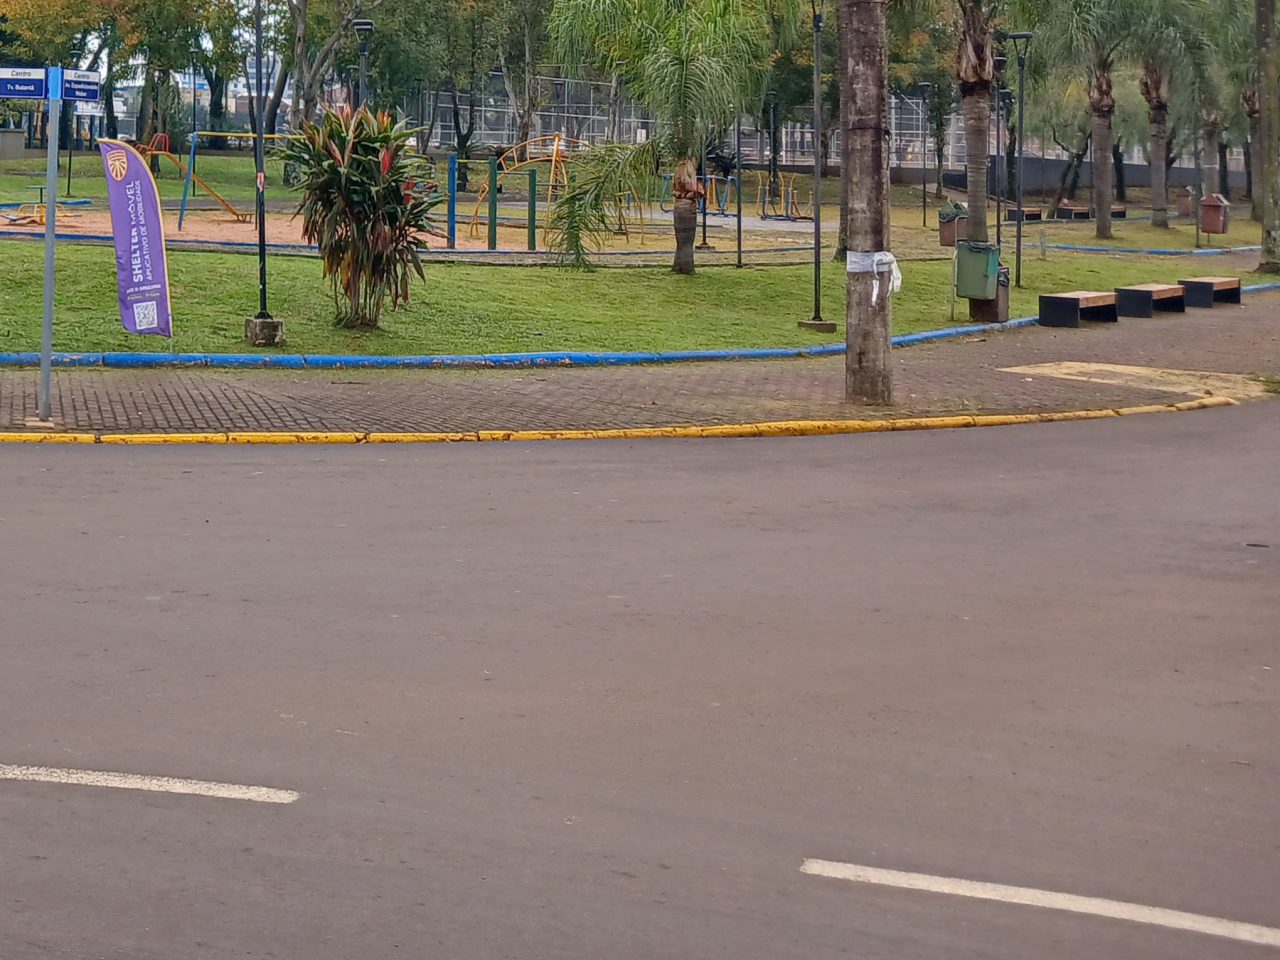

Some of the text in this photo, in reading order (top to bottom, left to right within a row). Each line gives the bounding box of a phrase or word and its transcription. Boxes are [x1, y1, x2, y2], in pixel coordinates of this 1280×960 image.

[126, 181, 144, 283] SHELTER MÓVEL
[136, 180, 152, 281] APLICATIVO DE MOBILIDADE
